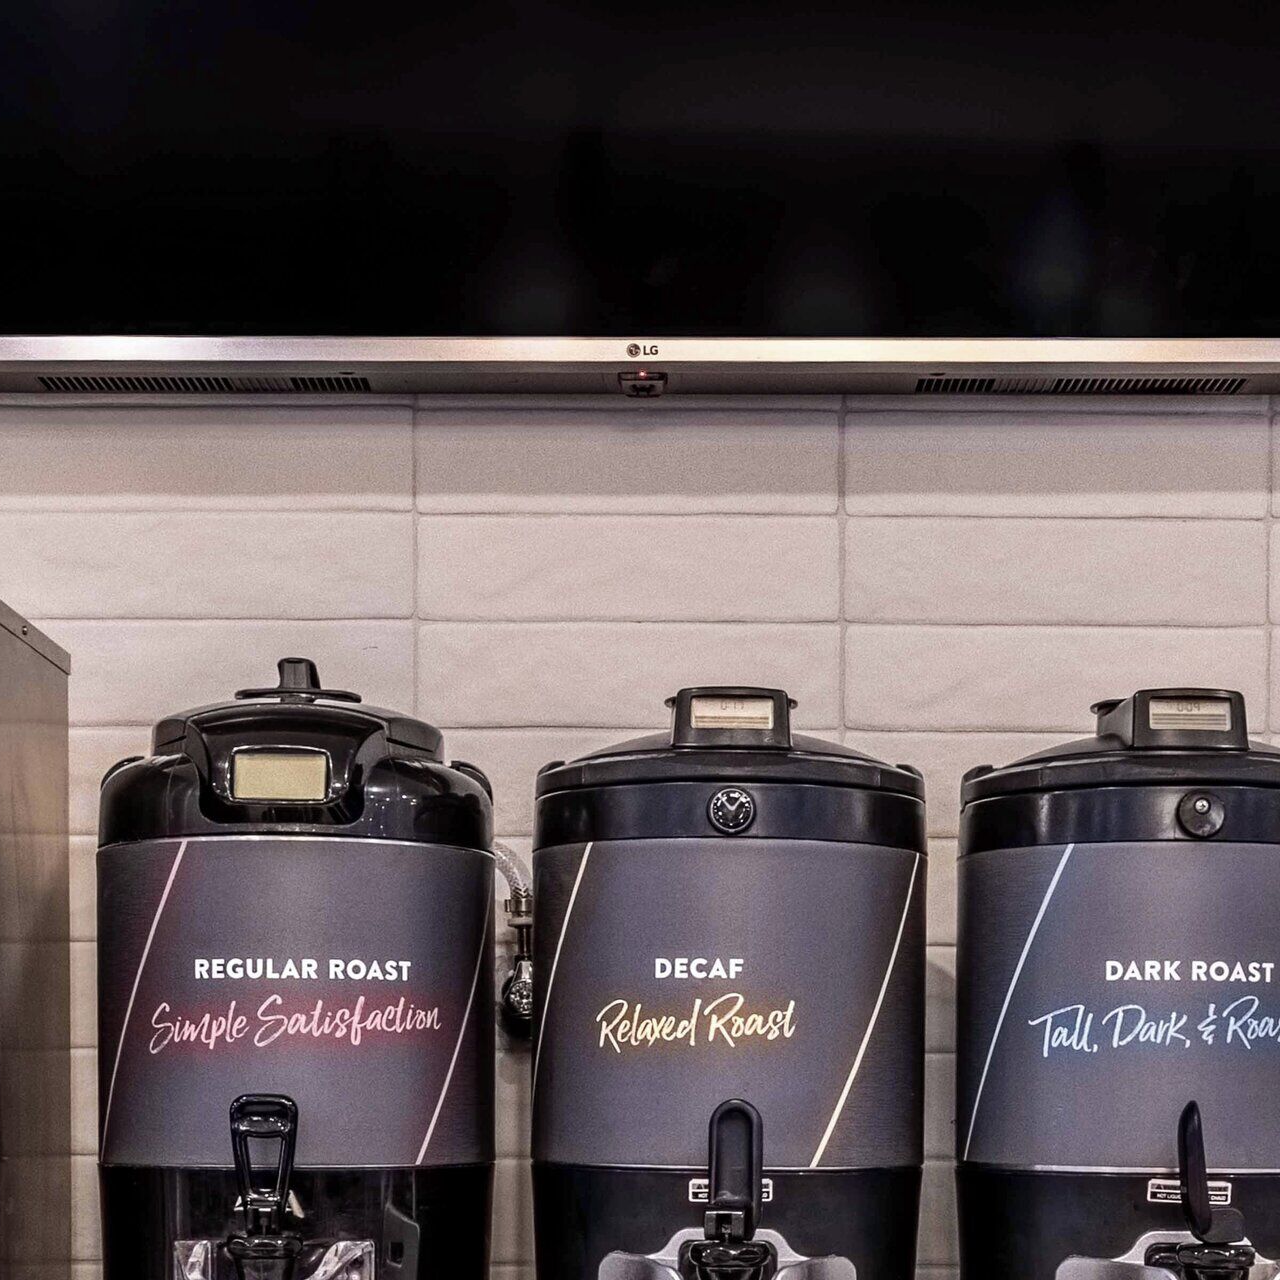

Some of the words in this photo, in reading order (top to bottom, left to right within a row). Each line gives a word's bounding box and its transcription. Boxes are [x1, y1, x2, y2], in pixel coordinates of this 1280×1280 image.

[643, 345, 659, 356] LG
[193, 958, 319, 980] REGULAR
[328, 960, 412, 982] ROAST
[654, 957, 745, 980] DECAF
[1105, 960, 1182, 982] DARK
[1191, 961, 1276, 983] ROAST
[149, 1001, 249, 1054] Simple
[254, 993, 442, 1048] Satisfaction
[596, 998, 702, 1054] Relaxed
[703, 992, 797, 1047] Roast
